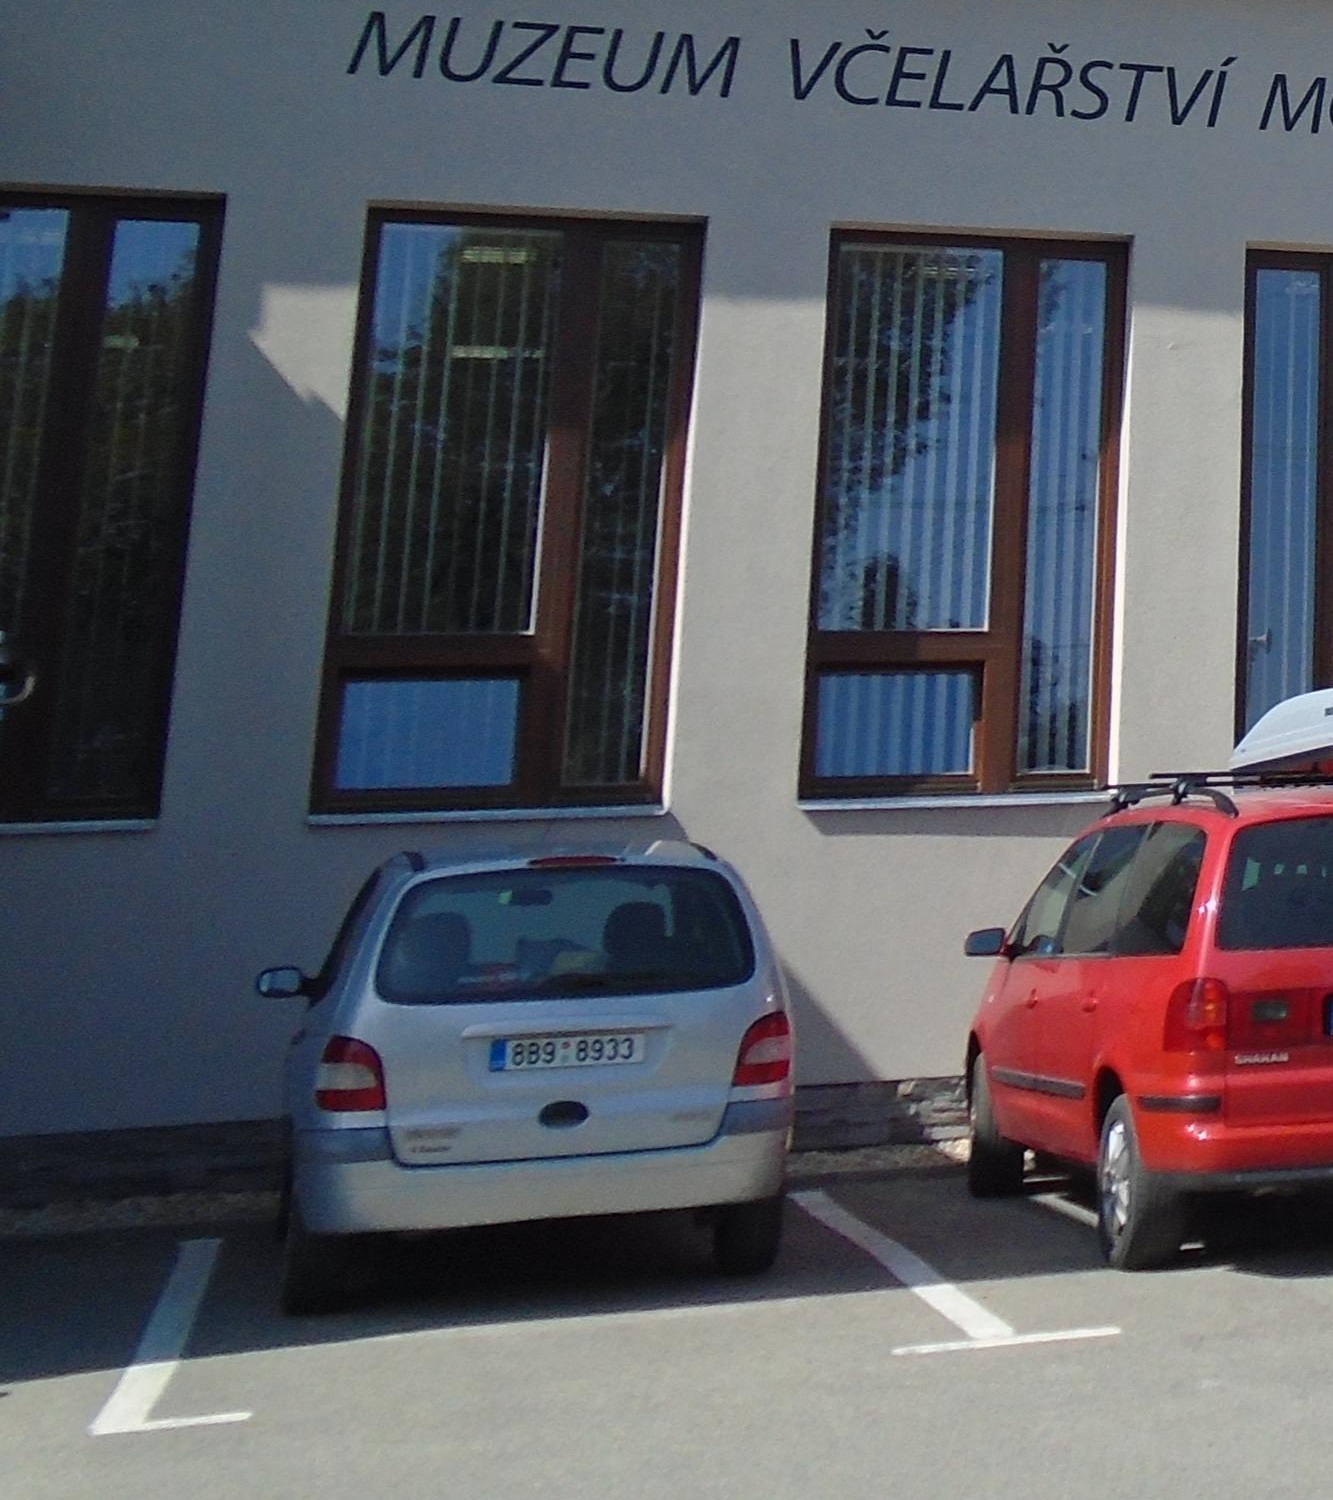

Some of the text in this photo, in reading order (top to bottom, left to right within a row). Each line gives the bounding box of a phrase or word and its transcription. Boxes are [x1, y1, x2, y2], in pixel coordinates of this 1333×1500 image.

[347, 11, 740, 98] MUZEUM
[790, 28, 1238, 127] VČELAŘSTVÍ
[512, 1038, 634, 1066] 8B9 8933
